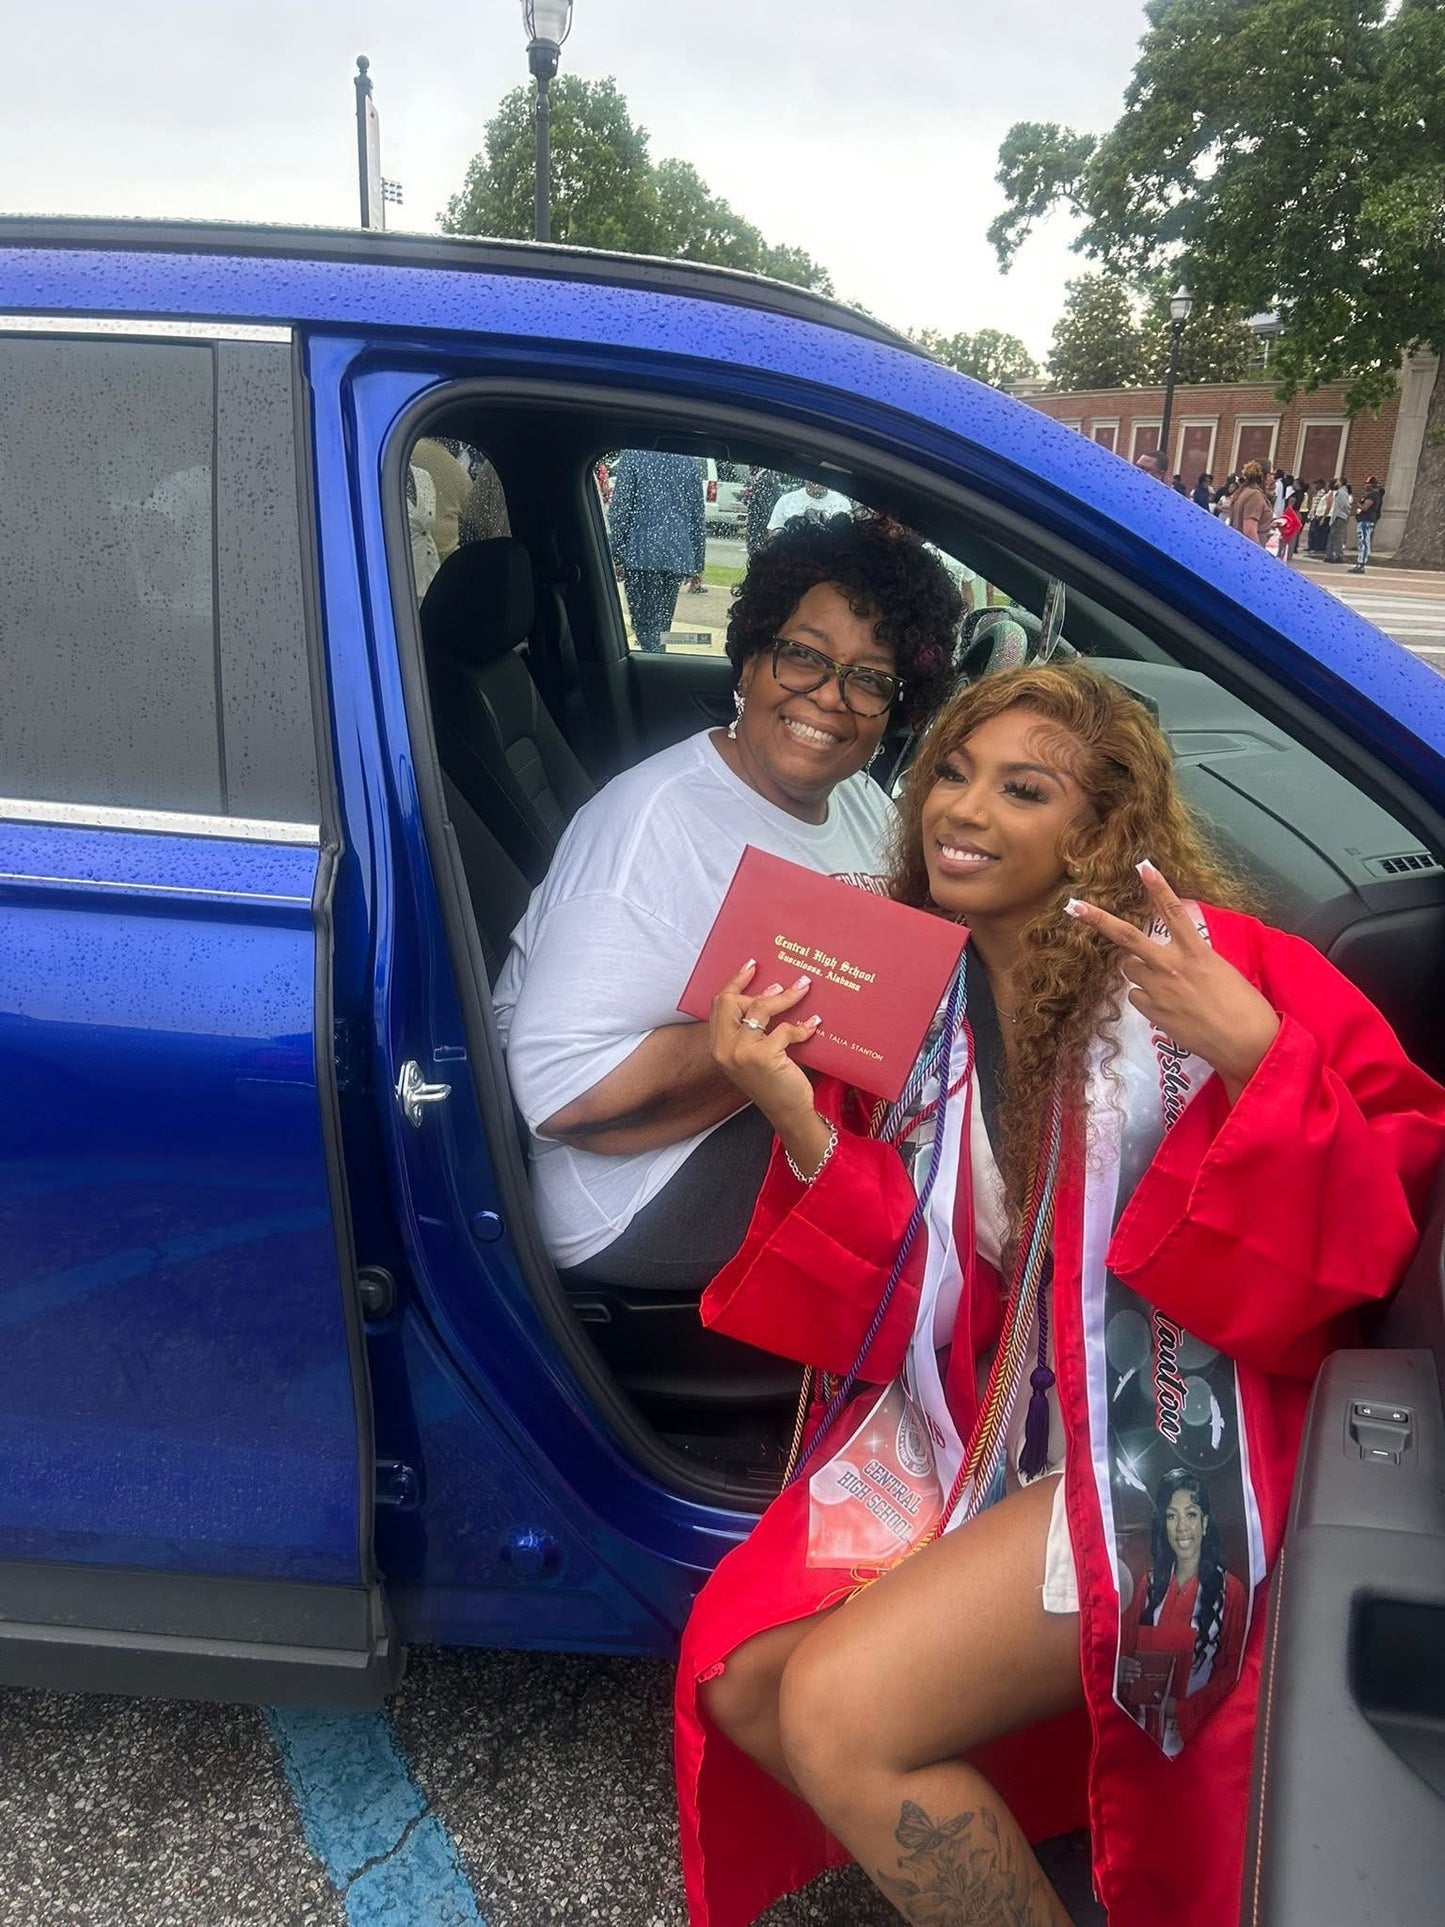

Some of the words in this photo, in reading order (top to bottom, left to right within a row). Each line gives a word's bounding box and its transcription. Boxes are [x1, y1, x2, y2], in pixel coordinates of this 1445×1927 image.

[775, 934, 811, 957] Central
[812, 949, 838, 970] High
[840, 961, 876, 983] School
[825, 970, 861, 992] Alabama
[829, 1033, 848, 1047] TALIA
[850, 1043, 884, 1062] STANTON
[1153, 1309, 1189, 1444] tanton
[836, 1471, 874, 1502] HIGH
[866, 1494, 914, 1541] SCHOOL
[863, 1459, 923, 1515] CENTRAL
